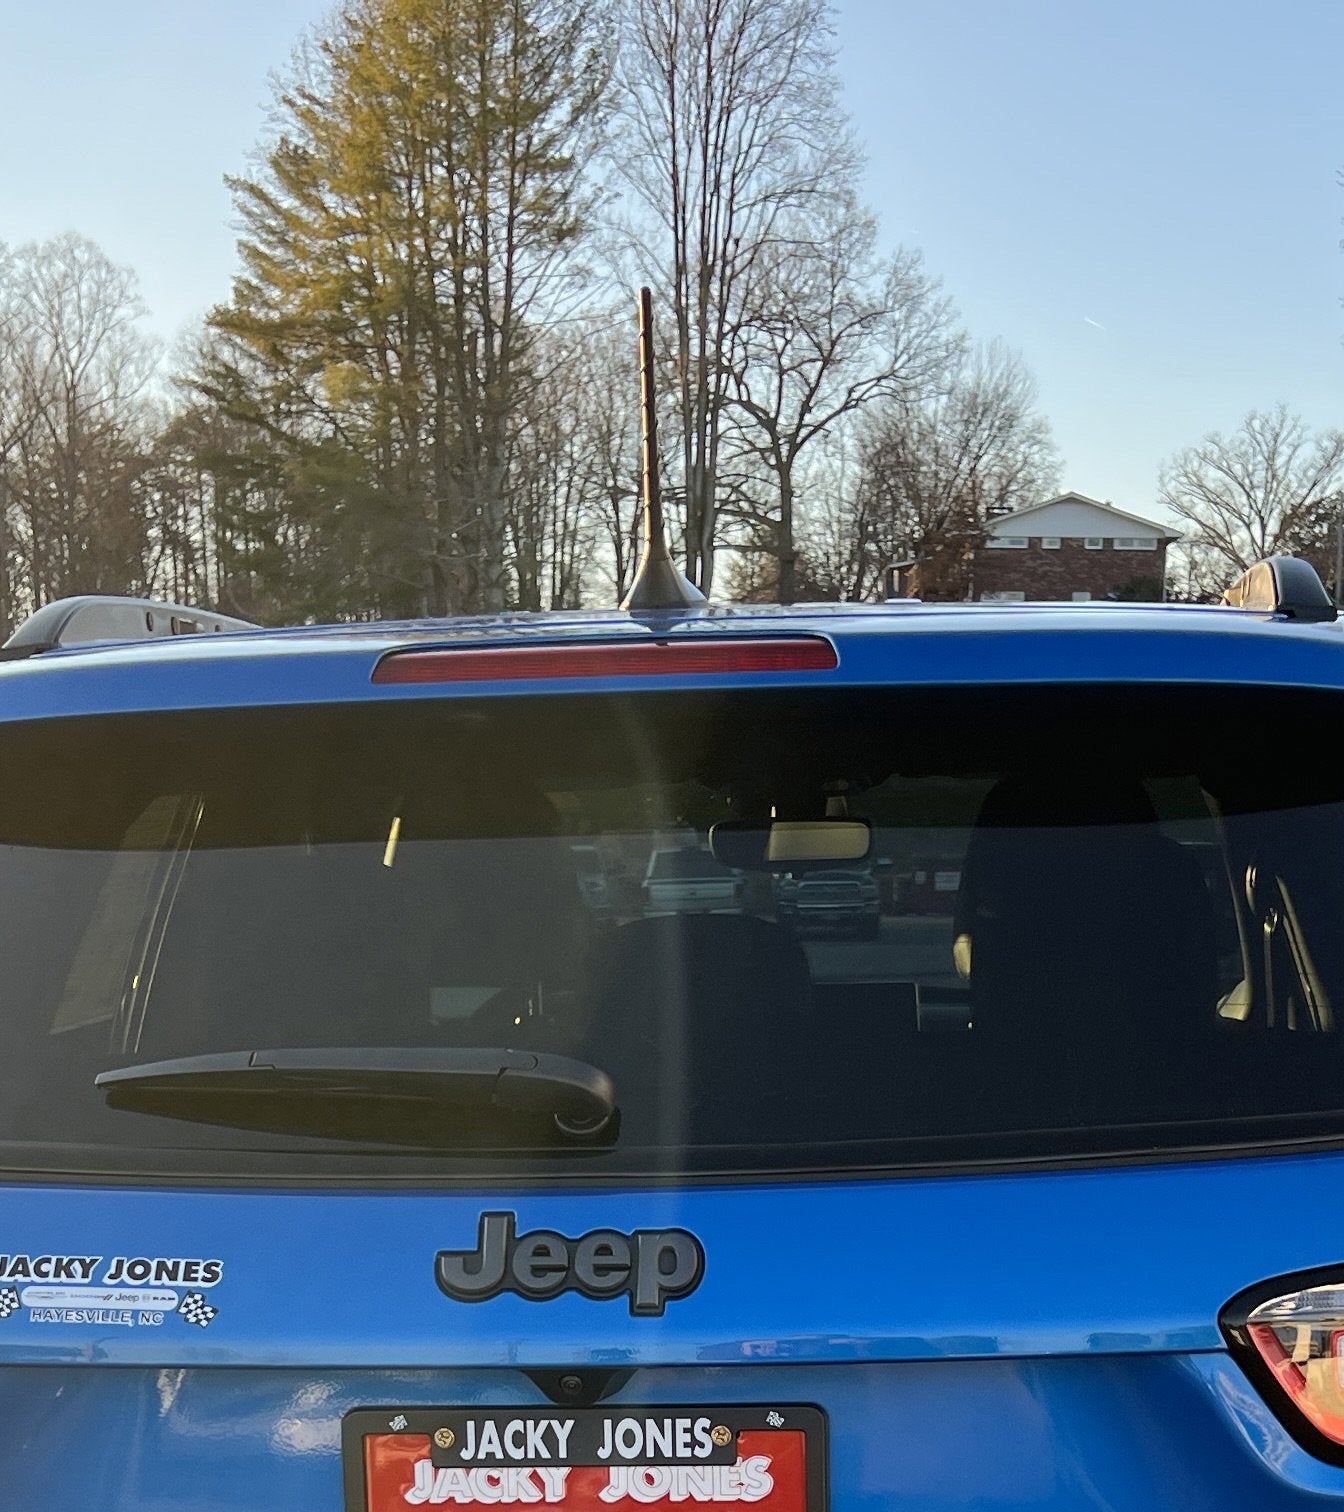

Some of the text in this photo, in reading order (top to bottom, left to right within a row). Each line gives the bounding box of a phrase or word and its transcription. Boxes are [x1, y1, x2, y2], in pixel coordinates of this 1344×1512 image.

[105, 1257, 223, 1285] JONES
[435, 1210, 706, 1317] Jeep
[31, 1310, 164, 1326] HAYESVILLE, NC
[460, 1417, 712, 1460] JACKY JONES
[405, 1454, 775, 1505] JACKY JONES
